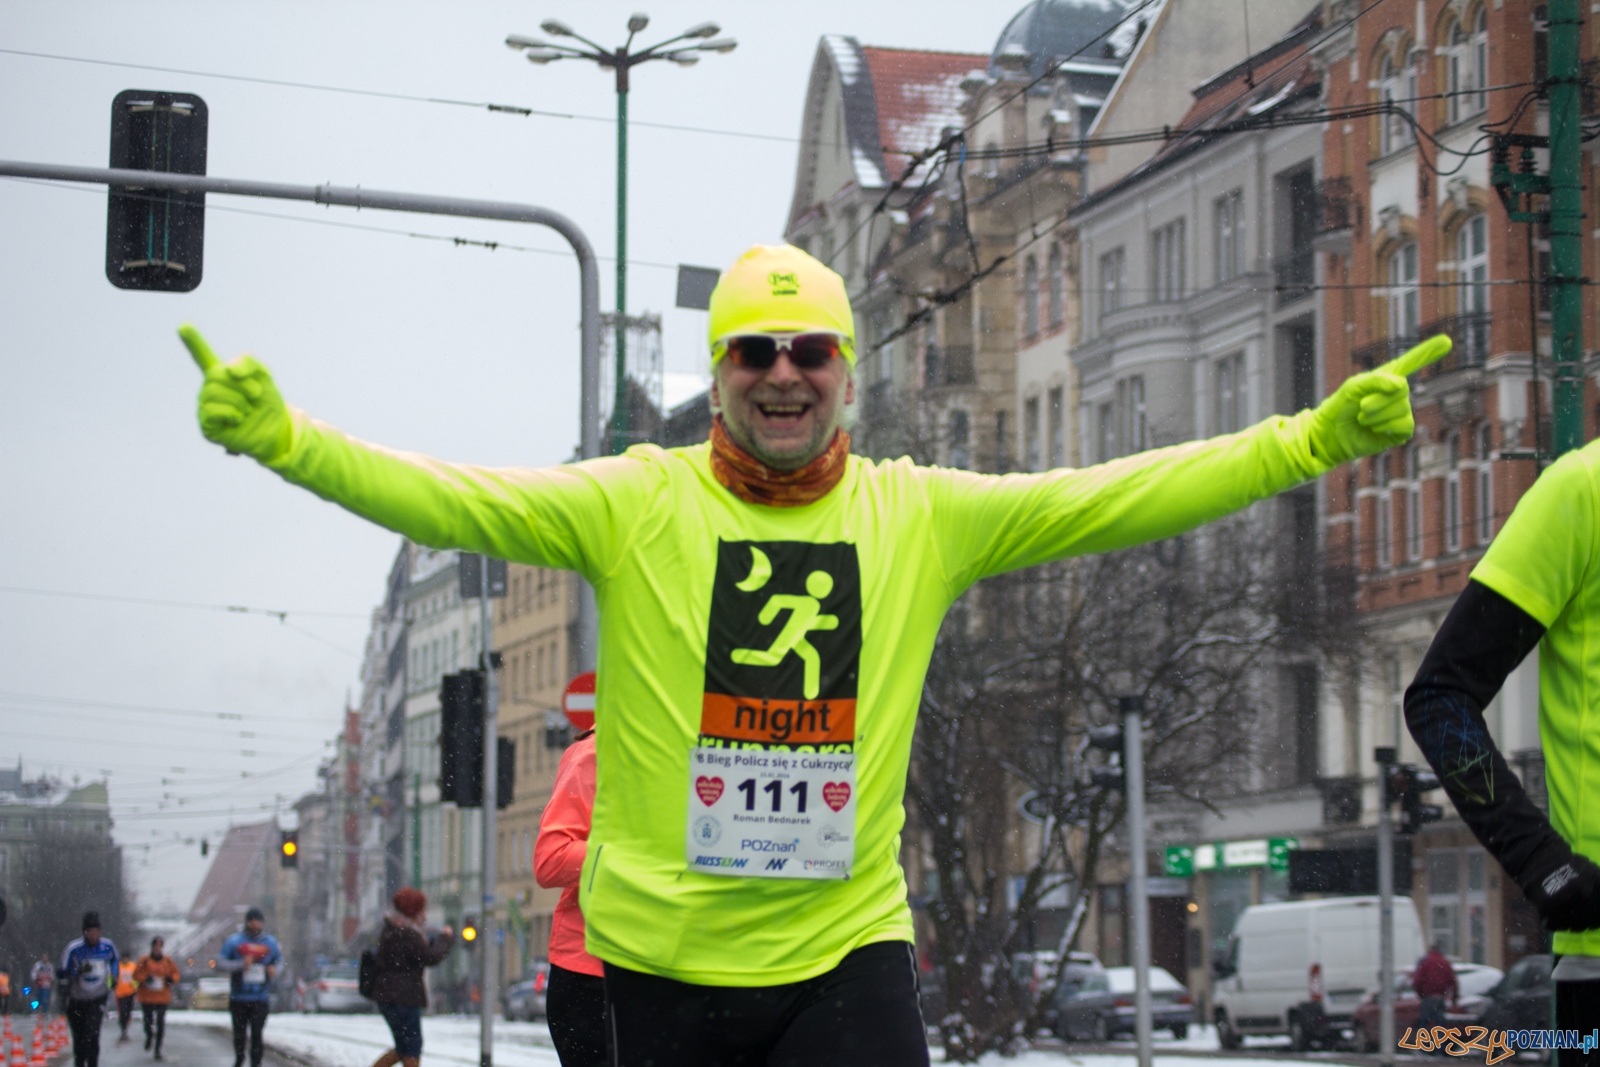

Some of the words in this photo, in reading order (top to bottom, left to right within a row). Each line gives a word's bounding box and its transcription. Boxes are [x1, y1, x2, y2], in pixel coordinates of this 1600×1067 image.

[734, 700, 831, 741] night
[707, 754, 731, 768] Bieg
[735, 755, 769, 768] Policz
[772, 757, 789, 770] się
[792, 760, 798, 769] z
[737, 779, 808, 813] 111
[733, 814, 766, 823] Roman
[768, 815, 811, 825] Bednarek
